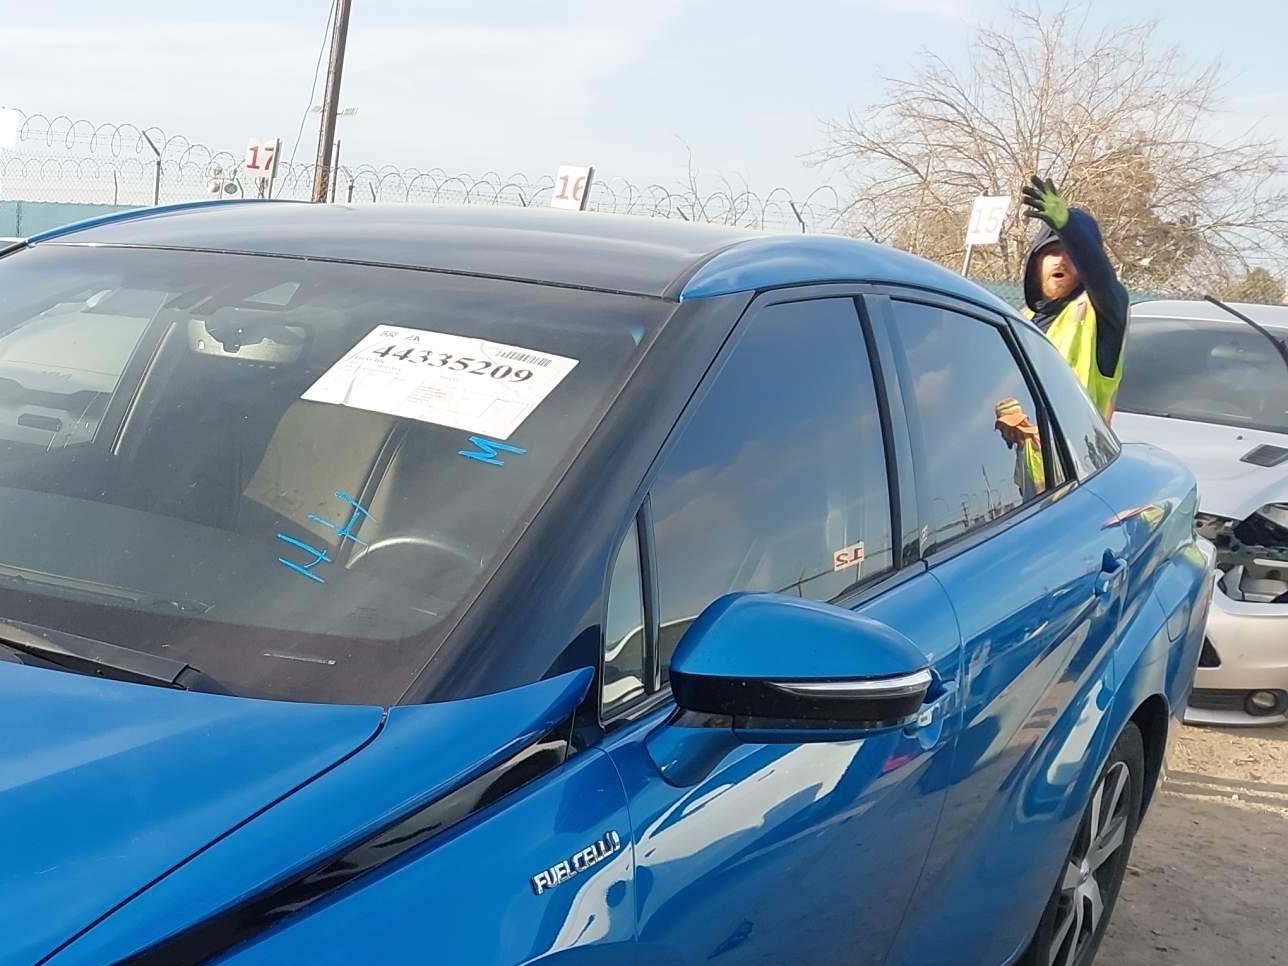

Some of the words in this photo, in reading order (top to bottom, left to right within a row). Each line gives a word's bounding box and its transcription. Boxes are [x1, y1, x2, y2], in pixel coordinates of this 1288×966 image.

[246, 145, 275, 171] 17
[969, 206, 1003, 234] 15
[372, 344, 534, 384] 44335209
[531, 860, 578, 895] FUEL
[572, 835, 615, 873] CELL
